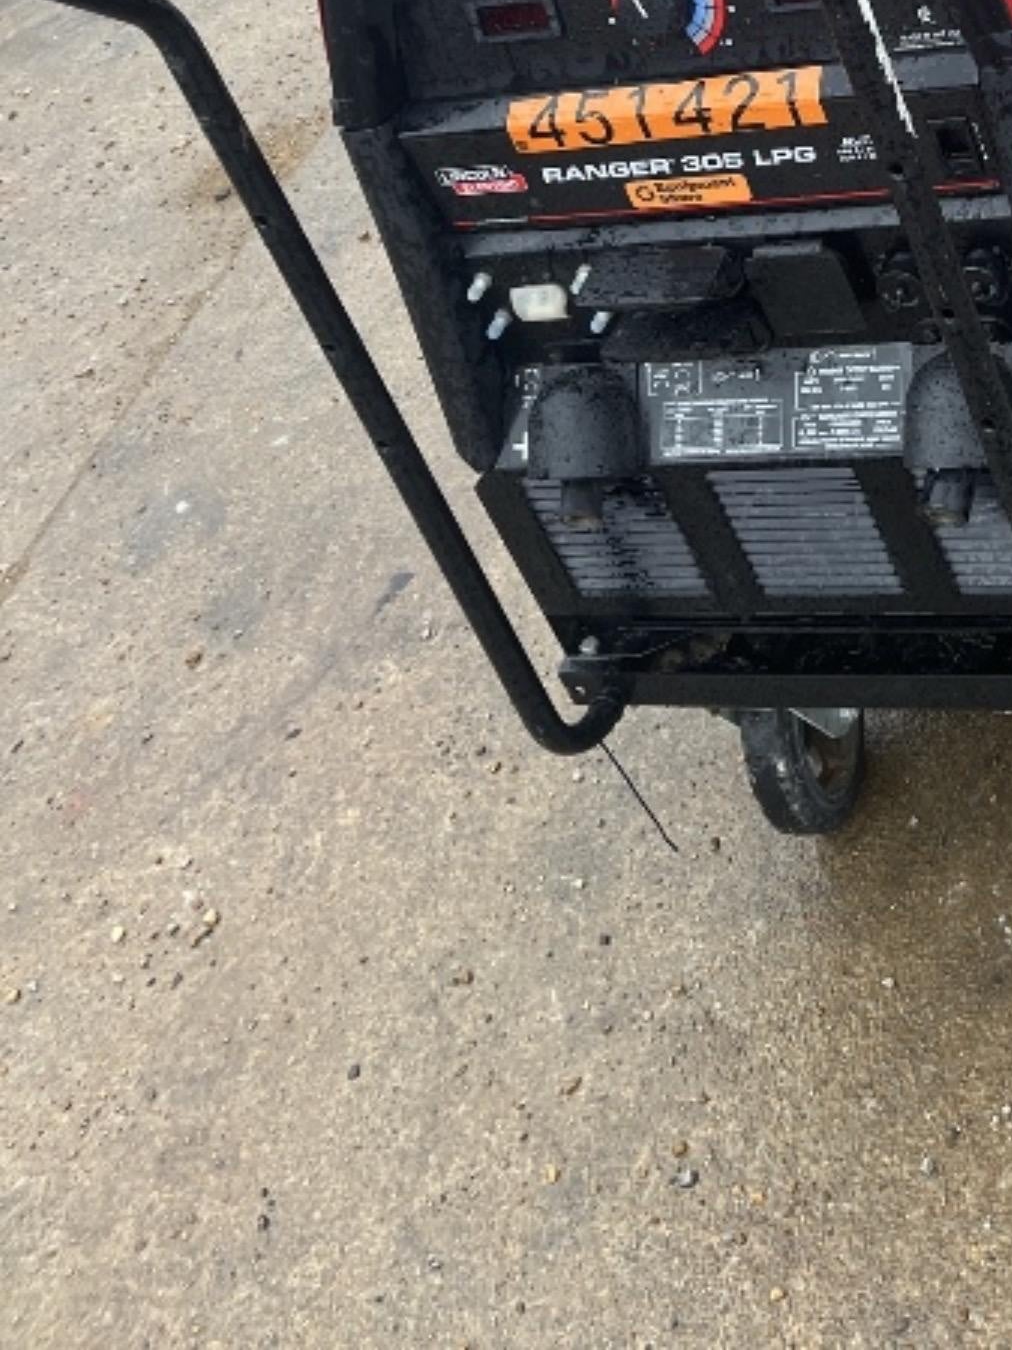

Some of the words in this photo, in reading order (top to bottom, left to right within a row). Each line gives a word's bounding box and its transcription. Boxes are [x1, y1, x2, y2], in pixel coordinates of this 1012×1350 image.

[528, 71, 805, 148] 451421
[542, 159, 670, 184] RANGER
[681, 151, 744, 173] 305
[753, 146, 817, 167] LPG
